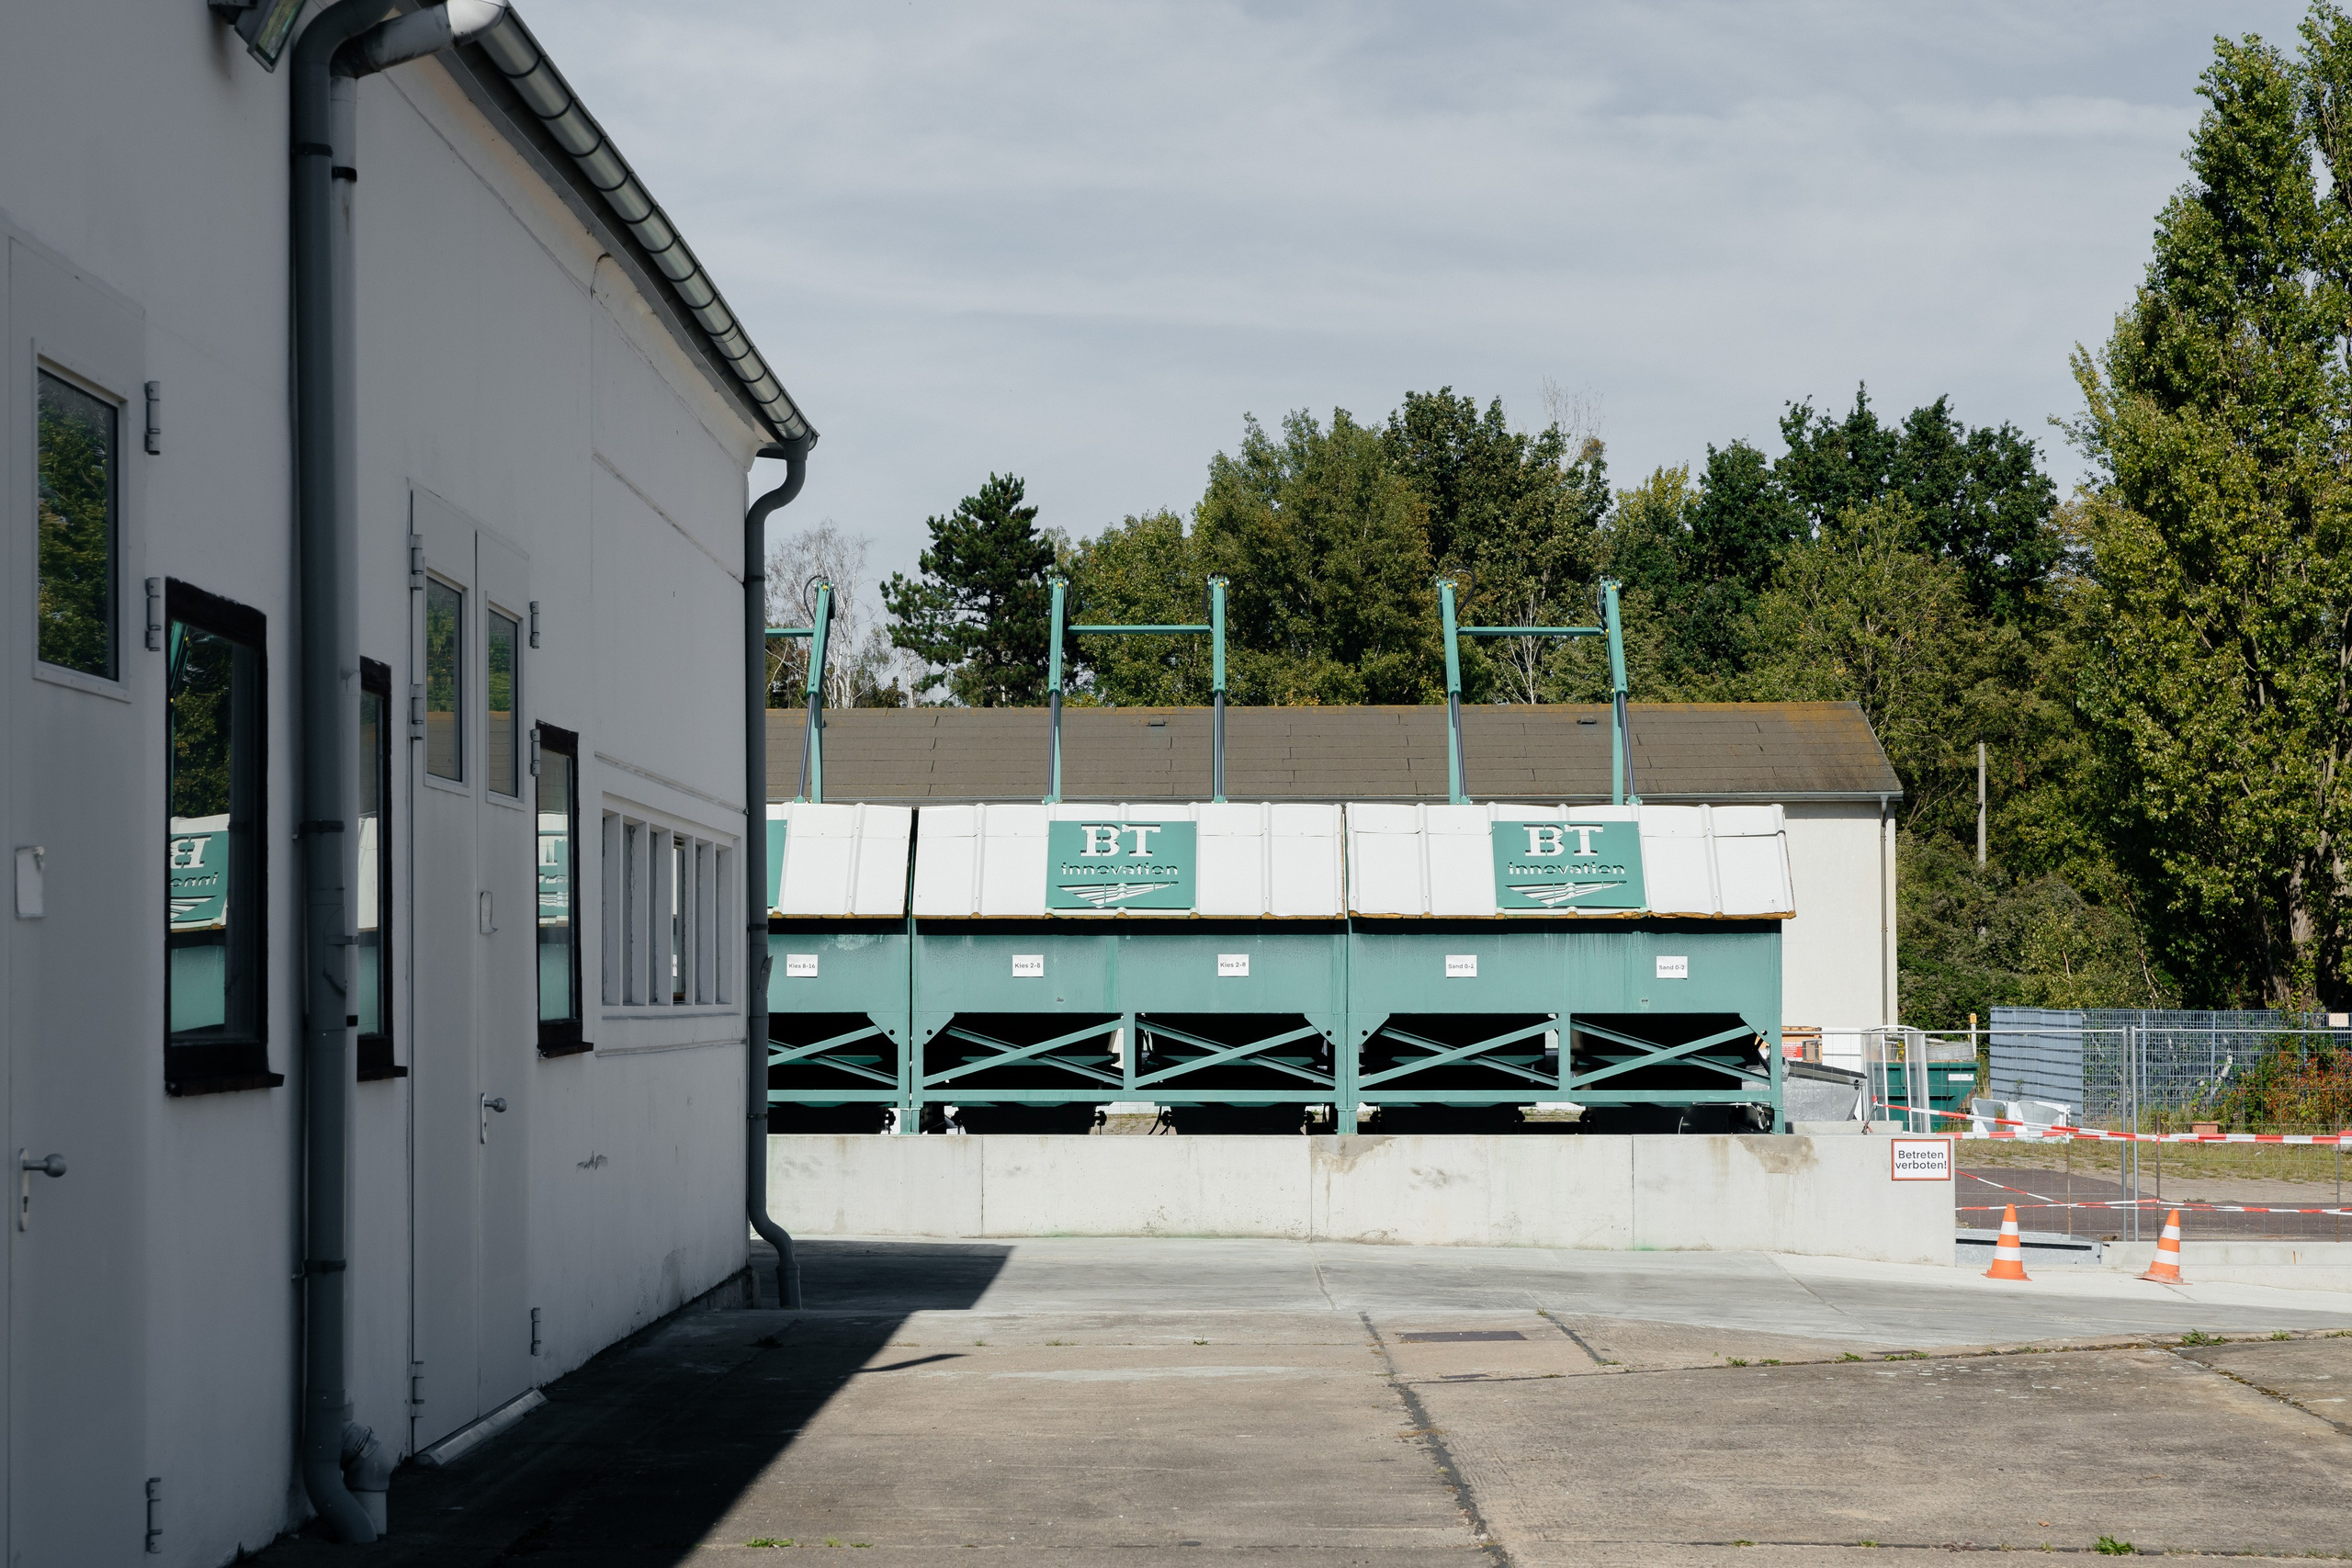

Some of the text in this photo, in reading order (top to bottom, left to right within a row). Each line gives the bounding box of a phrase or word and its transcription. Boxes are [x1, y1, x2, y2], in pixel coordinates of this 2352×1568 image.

[1080, 823, 1161, 857] BT
[1522, 823, 1604, 857] BT
[1060, 862, 1179, 875] innovation
[1507, 861, 1625, 874] innovation
[1898, 1150, 1944, 1159] Betreten
[1894, 1159, 1947, 1169] verboten!
